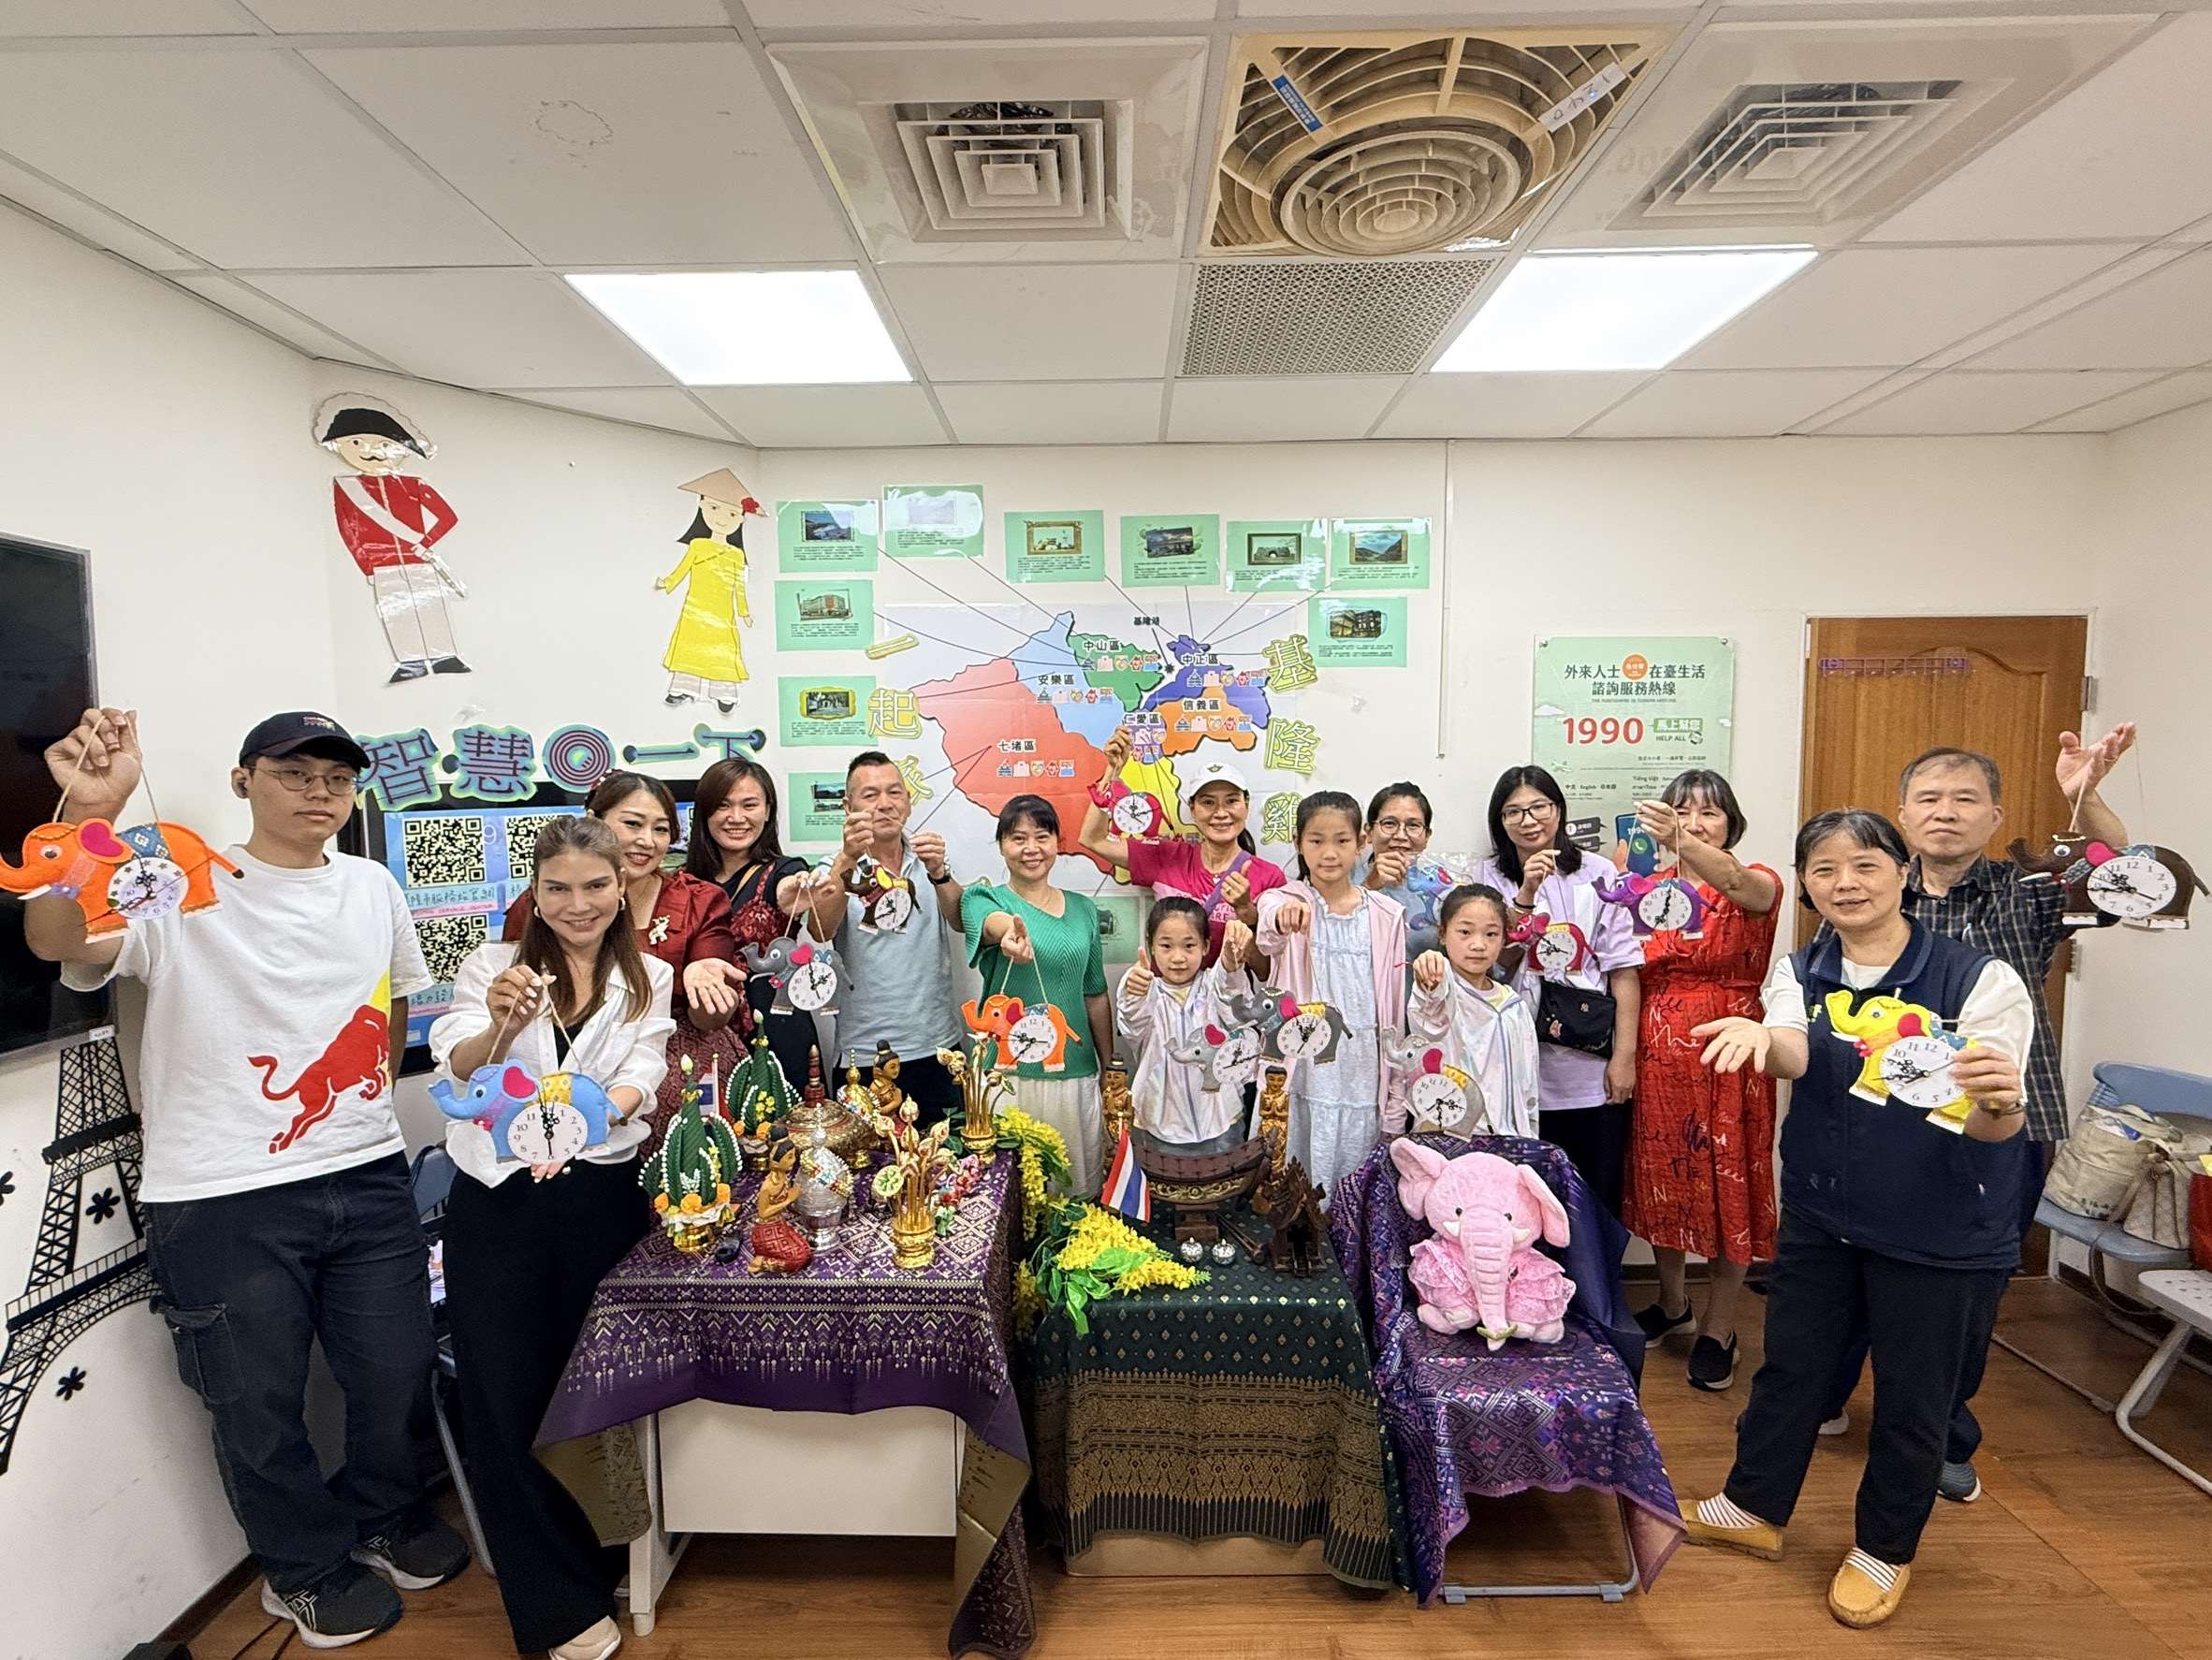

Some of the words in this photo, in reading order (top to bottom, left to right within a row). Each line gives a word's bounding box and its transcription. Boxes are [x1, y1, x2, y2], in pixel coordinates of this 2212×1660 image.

[1083, 639, 1120, 652] 中山區
[1182, 653, 1218, 664] 中正區
[1564, 663, 1621, 679] 外來人士
[1649, 663, 1706, 679] 在臺生活
[1038, 674, 1075, 685] 安樂區
[1592, 681, 1677, 696] 諮詢服務熱線
[1183, 699, 1220, 710] 信義區
[1124, 713, 1160, 724] 仁愛區
[1563, 717, 1644, 745] 1990
[998, 739, 1036, 752] 七堵區
[1908, 1041, 1918, 1052] 11
[1925, 1042, 1938, 1053] 12
[1893, 1048, 1906, 1058] 10
[526, 1113, 536, 1121] 11
[517, 1123, 529, 1131] 10
